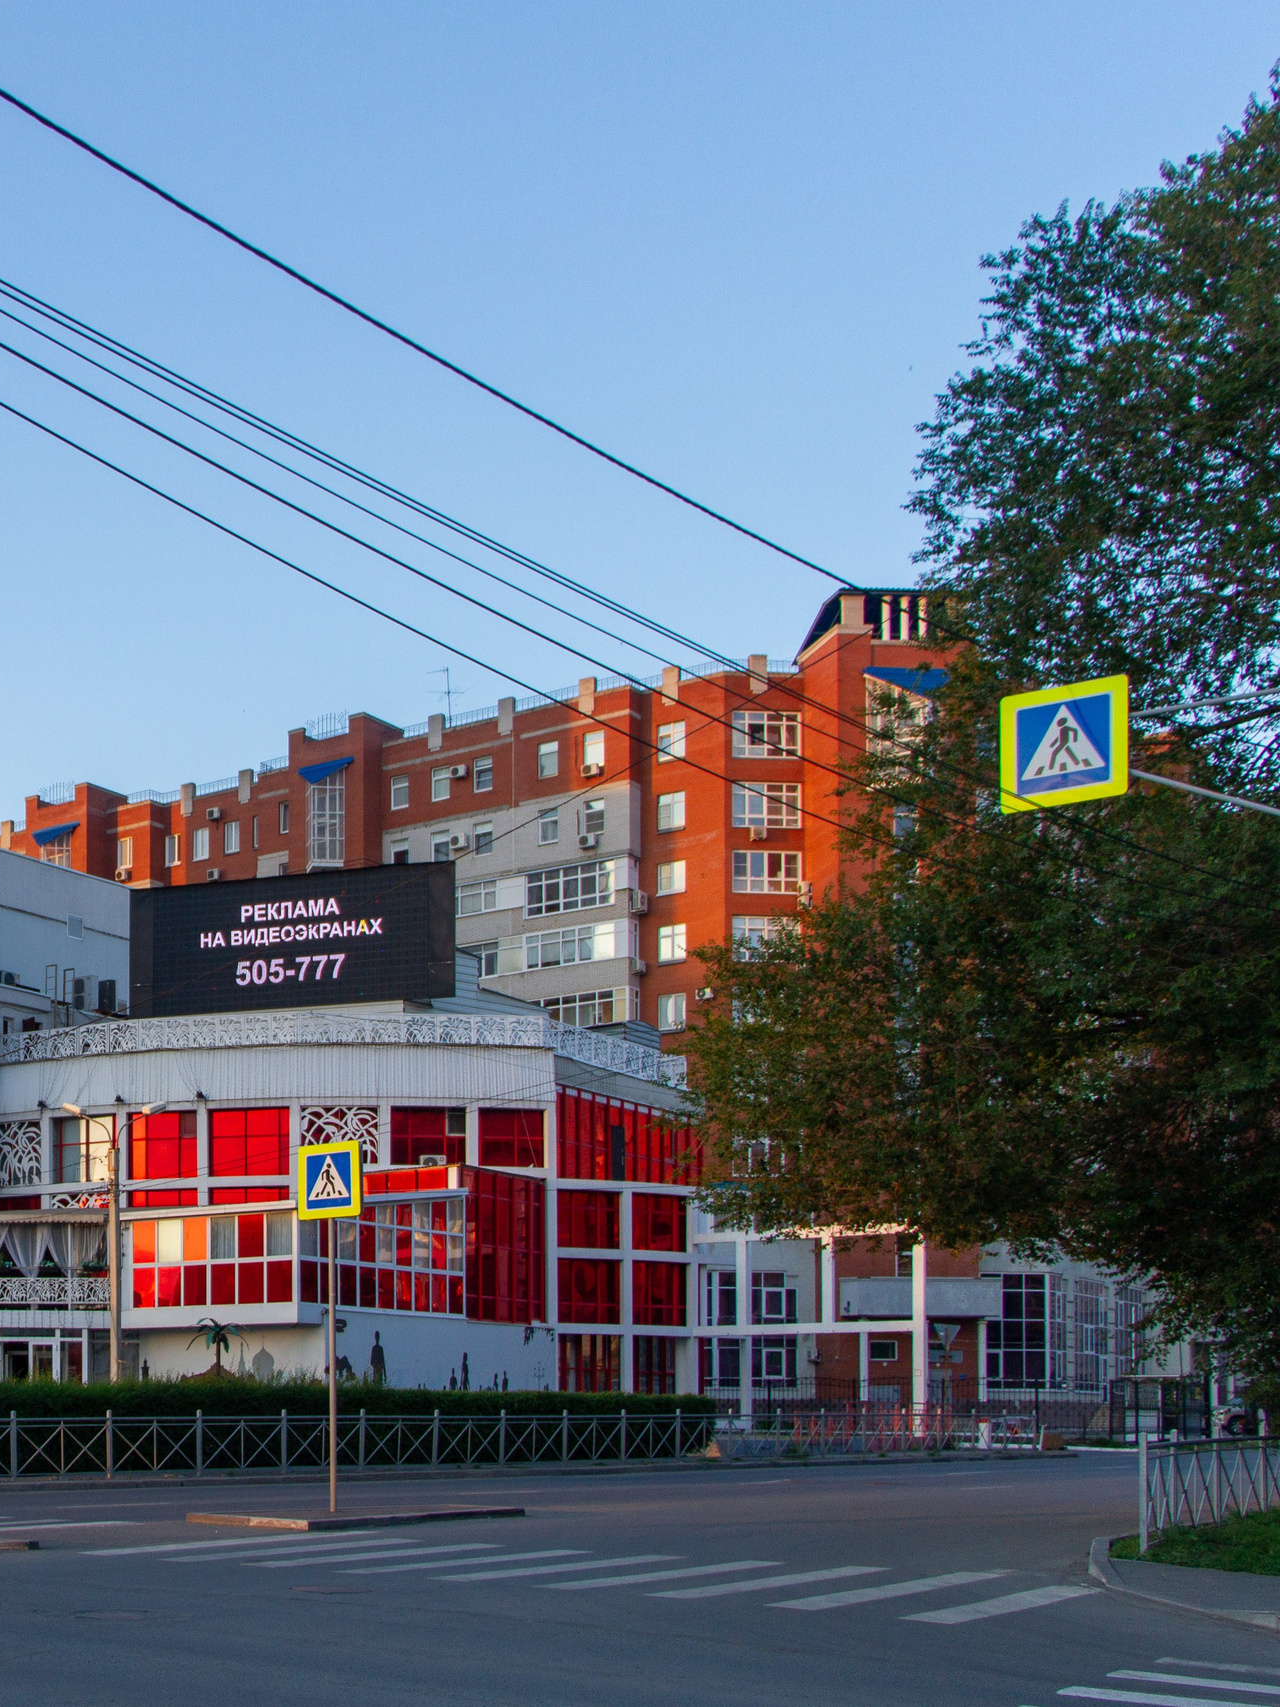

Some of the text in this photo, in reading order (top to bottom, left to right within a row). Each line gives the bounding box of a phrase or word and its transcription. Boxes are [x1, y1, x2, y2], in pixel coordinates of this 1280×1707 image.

[240, 897, 340, 923] РЕКЛАМА
[200, 918, 383, 949] НА ВИДЕОЭКРАНАХ
[235, 953, 346, 986] 505-777
